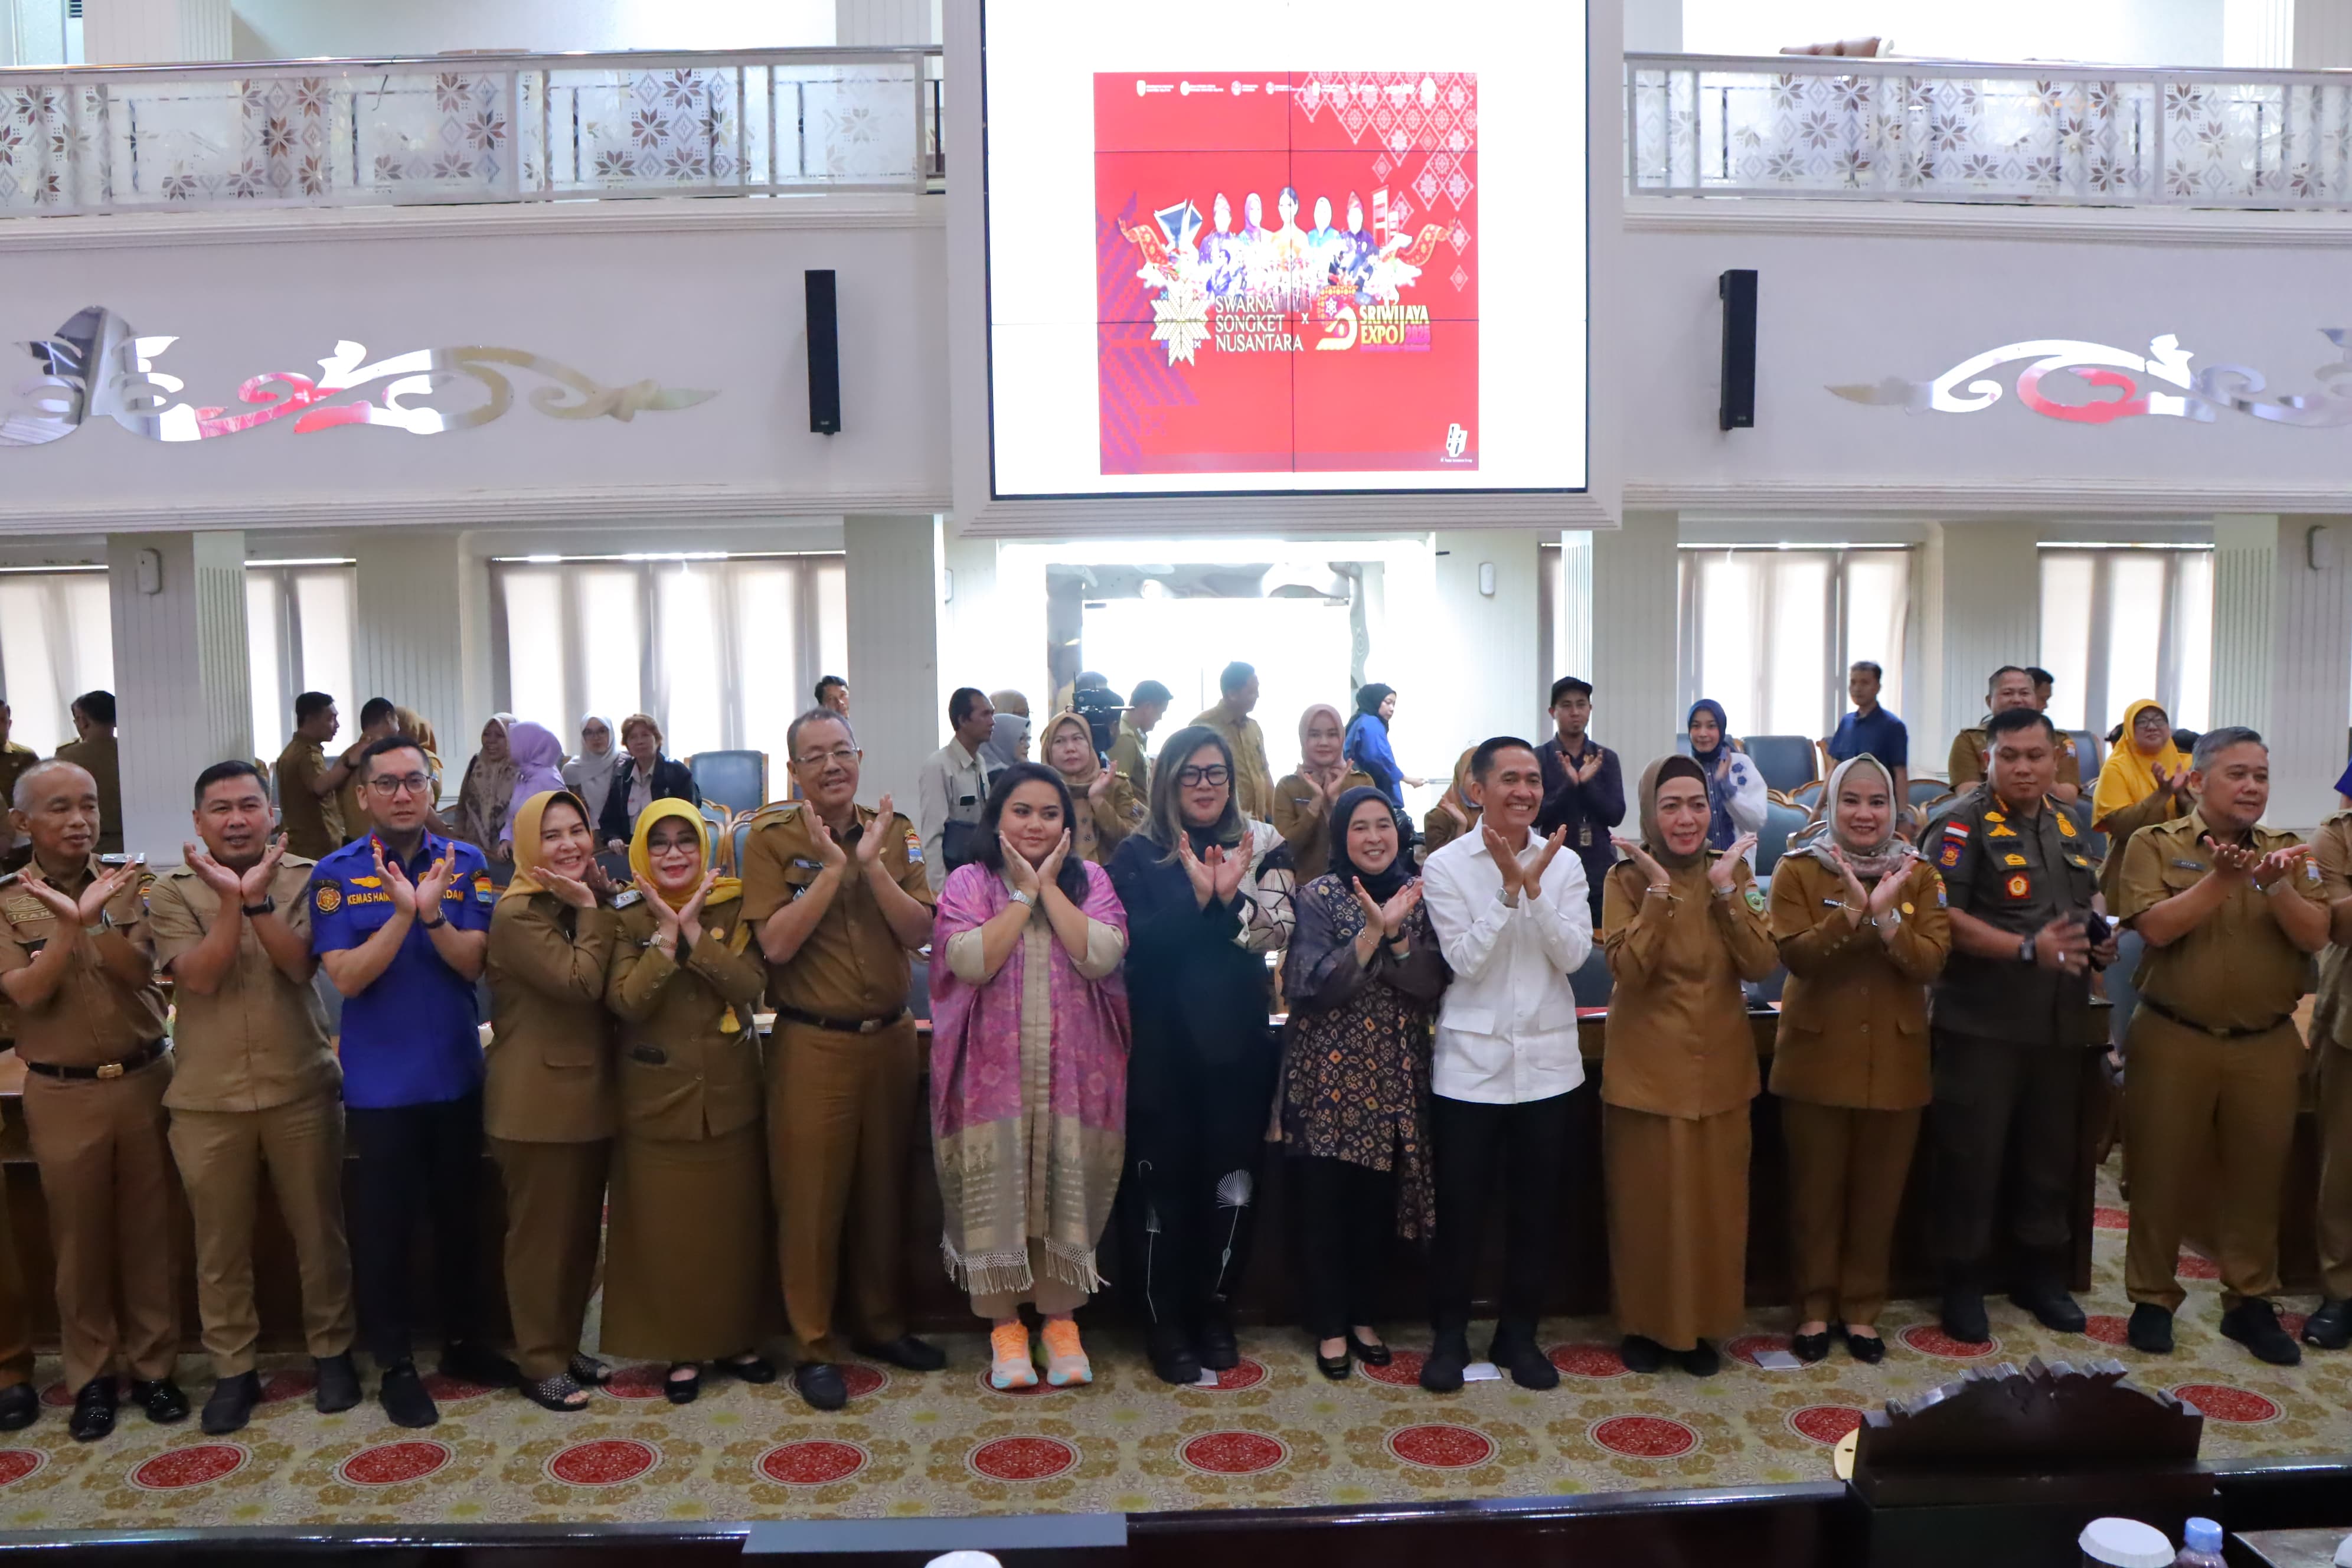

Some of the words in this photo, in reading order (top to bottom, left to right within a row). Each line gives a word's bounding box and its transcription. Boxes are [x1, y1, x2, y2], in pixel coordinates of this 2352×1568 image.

[1216, 295, 1276, 313] SWARNA
[1215, 314, 1285, 332] SONGKET
[1215, 334, 1304, 352] NUSANTARA
[1361, 325, 1399, 344] EXPO
[347, 892, 373, 906] KEMAS
[443, 889, 464, 901] DAM
